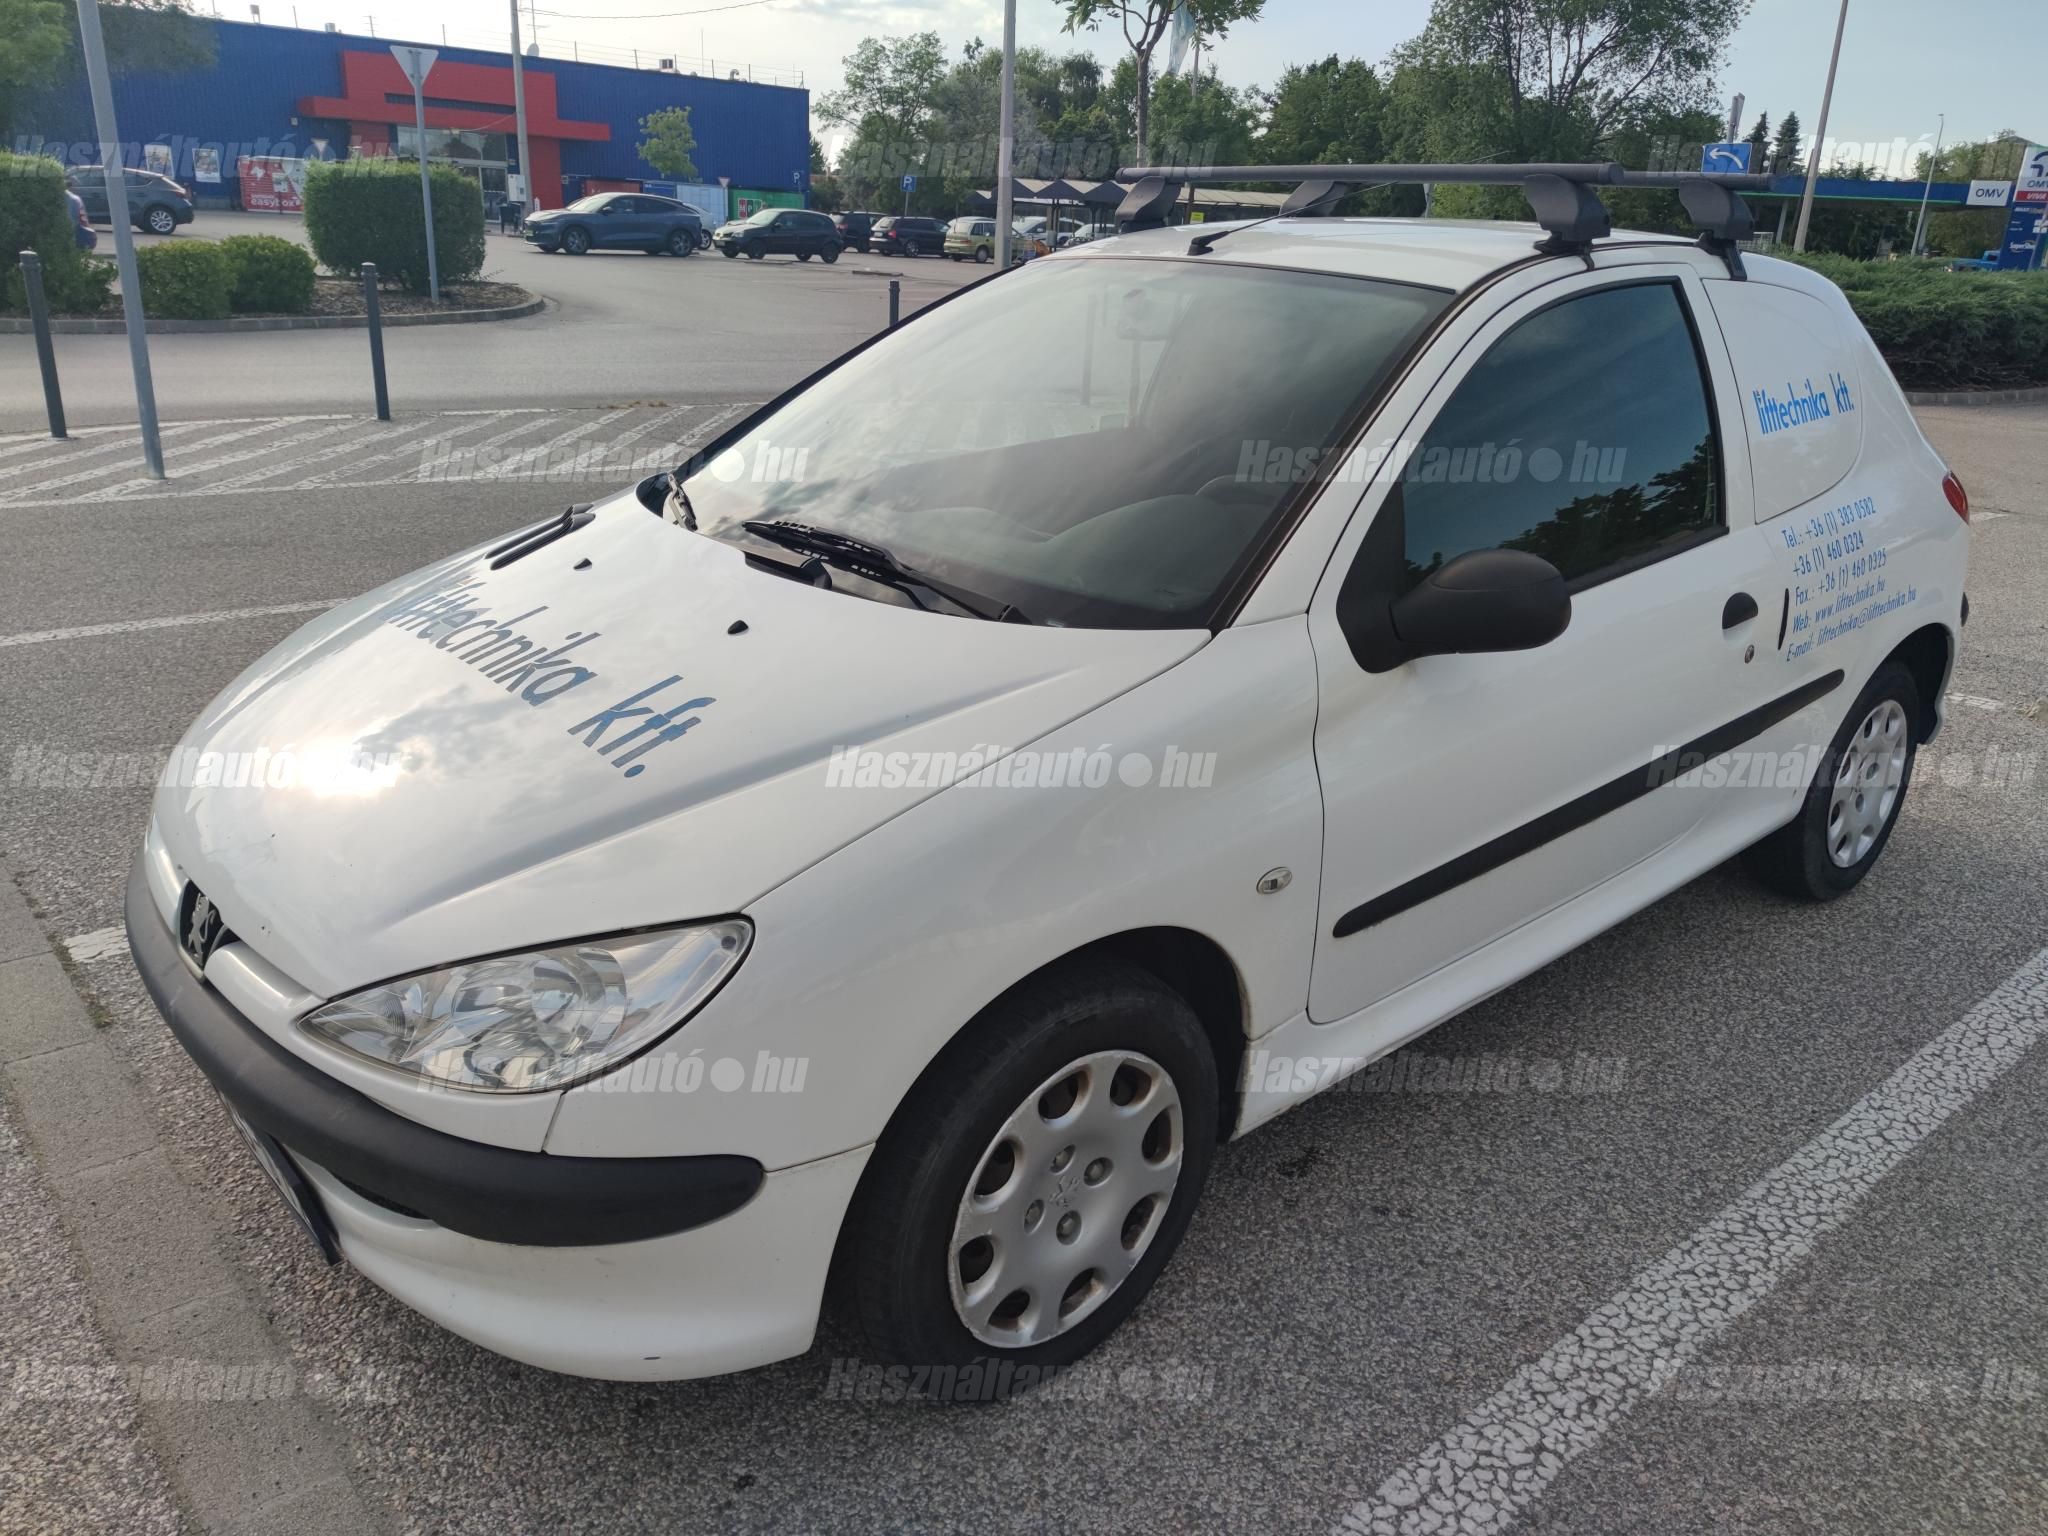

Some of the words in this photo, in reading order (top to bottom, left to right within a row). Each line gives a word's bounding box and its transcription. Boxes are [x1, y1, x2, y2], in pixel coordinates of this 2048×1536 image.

[903, 175, 913, 188] P
[1975, 187, 2005, 198] OMV
[2026, 191, 2048, 200] VIVA
[1752, 378, 1830, 434] lifttechnika
[1828, 371, 1855, 414] kft.
[1781, 526, 1804, 549] Tel.:
[1805, 516, 1824, 540] +36
[1824, 511, 1839, 537] (1)
[1838, 504, 1855, 527] 383
[1855, 496, 1876, 520] 0582
[1793, 553, 1812, 577] +36
[1812, 544, 1825, 573] (1)
[1827, 539, 1842, 561] 460
[1843, 529, 1865, 555] 0324
[1795, 585, 1815, 607] Fax.:
[1818, 571, 1836, 595] +36
[1838, 563, 1849, 591] (1)
[1851, 557, 1866, 580] 460
[1868, 547, 1887, 572] 0325
[1792, 609, 1811, 634] Web:
[567, 674, 717, 778] kft.
